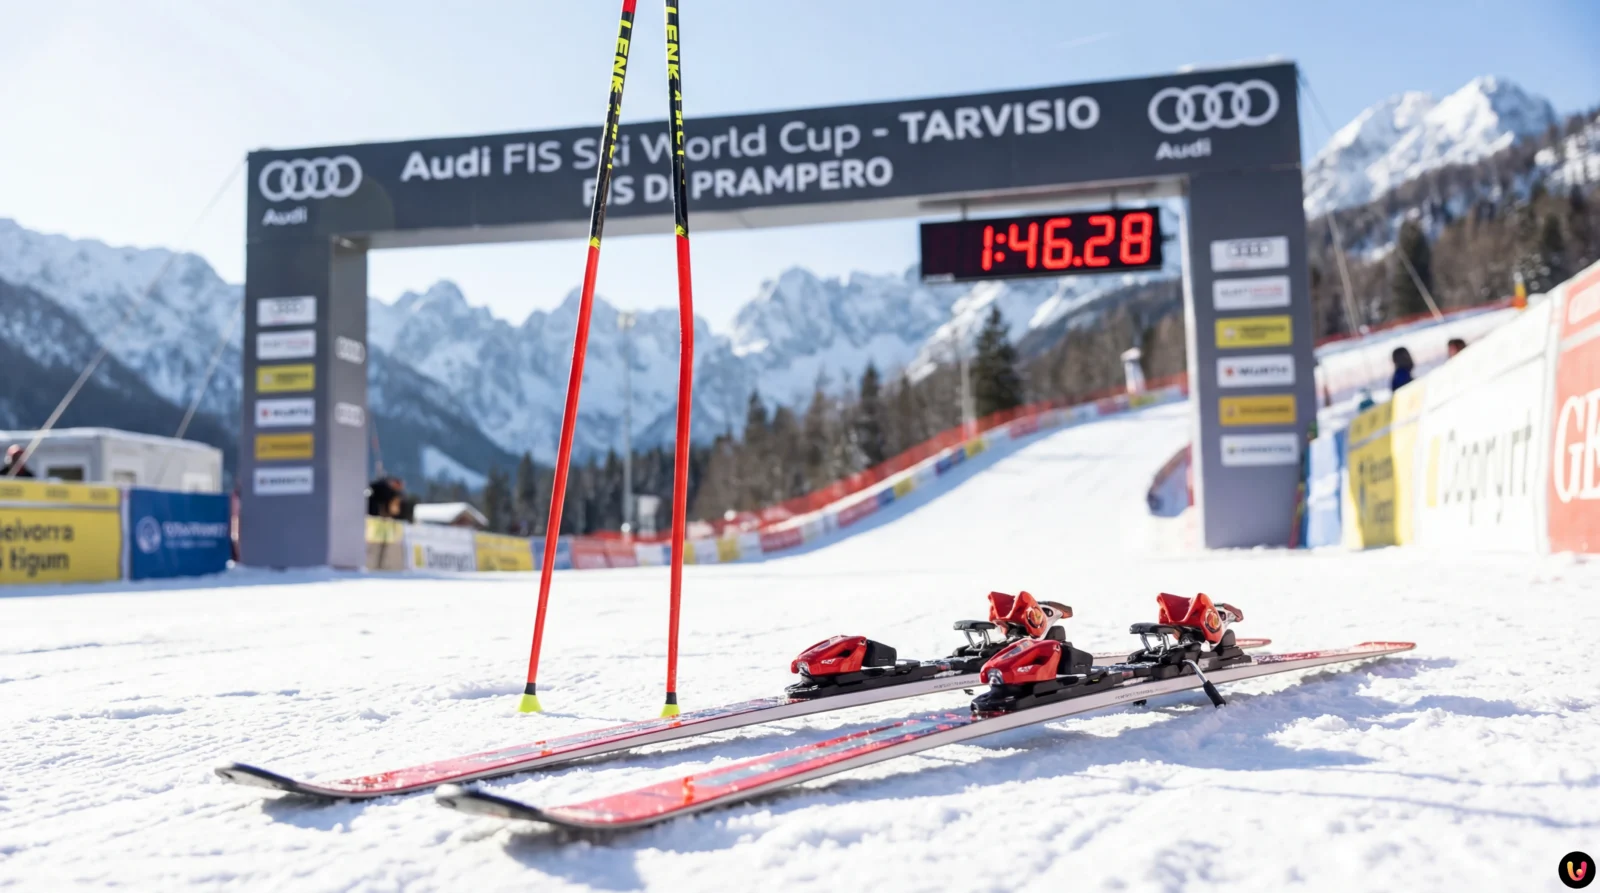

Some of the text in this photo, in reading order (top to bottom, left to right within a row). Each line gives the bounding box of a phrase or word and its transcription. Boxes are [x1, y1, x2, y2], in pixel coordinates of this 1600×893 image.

[400, 145, 491, 183] Audi
[503, 139, 562, 175] FIS
[640, 124, 767, 164] World
[779, 121, 861, 157] Cup
[899, 96, 1100, 144] TARVISIO
[1155, 137, 1211, 160] Audi
[691, 155, 894, 201] PRAMPERO
[262, 205, 308, 226] Audi
[981, 211, 1153, 272] 1:46.28
